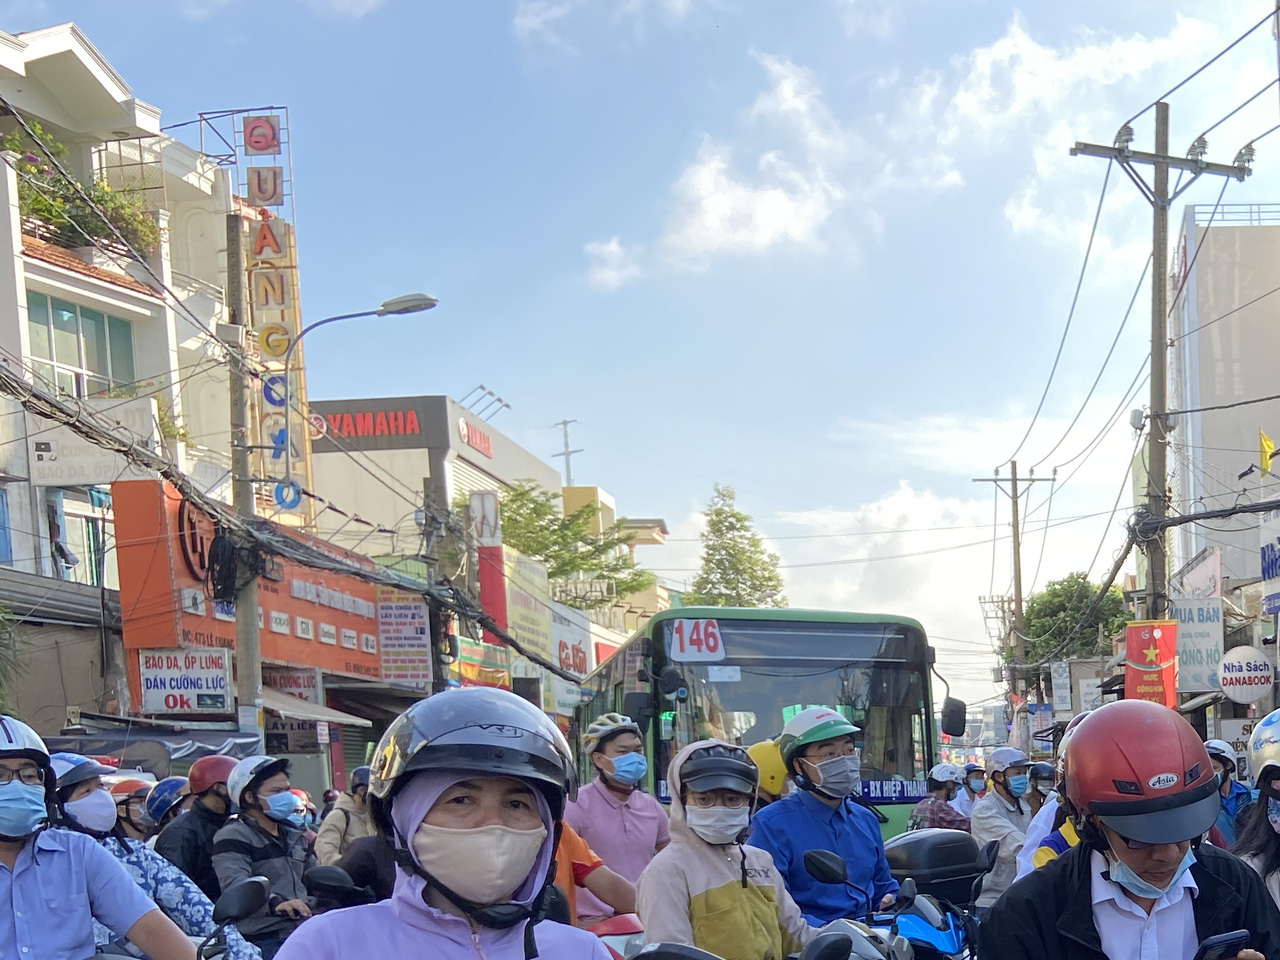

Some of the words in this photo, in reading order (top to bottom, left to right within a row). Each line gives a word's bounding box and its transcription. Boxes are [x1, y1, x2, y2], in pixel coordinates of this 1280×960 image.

[327, 410, 420, 438] YAMAHA
[1200, 602, 1220, 624] BÁN
[674, 619, 719, 654] 146
[145, 655, 164, 670] BAO
[166, 655, 182, 672] DA,
[184, 651, 197, 670] ỐP
[199, 655, 224, 670] LƯNG
[1223, 660, 1244, 674] Nhà
[1246, 660, 1270, 673] Sách
[145, 674, 167, 690] DÁN
[169, 673, 203, 690] CƯỜNG
[205, 676, 225, 691] LỰC
[1221, 675, 1272, 687] DANABOOK
[164, 693, 191, 709] Ok
[869, 780, 882, 798] BX
[883, 777, 901, 801] HIỆP
[1151, 774, 1176, 787] Asia
